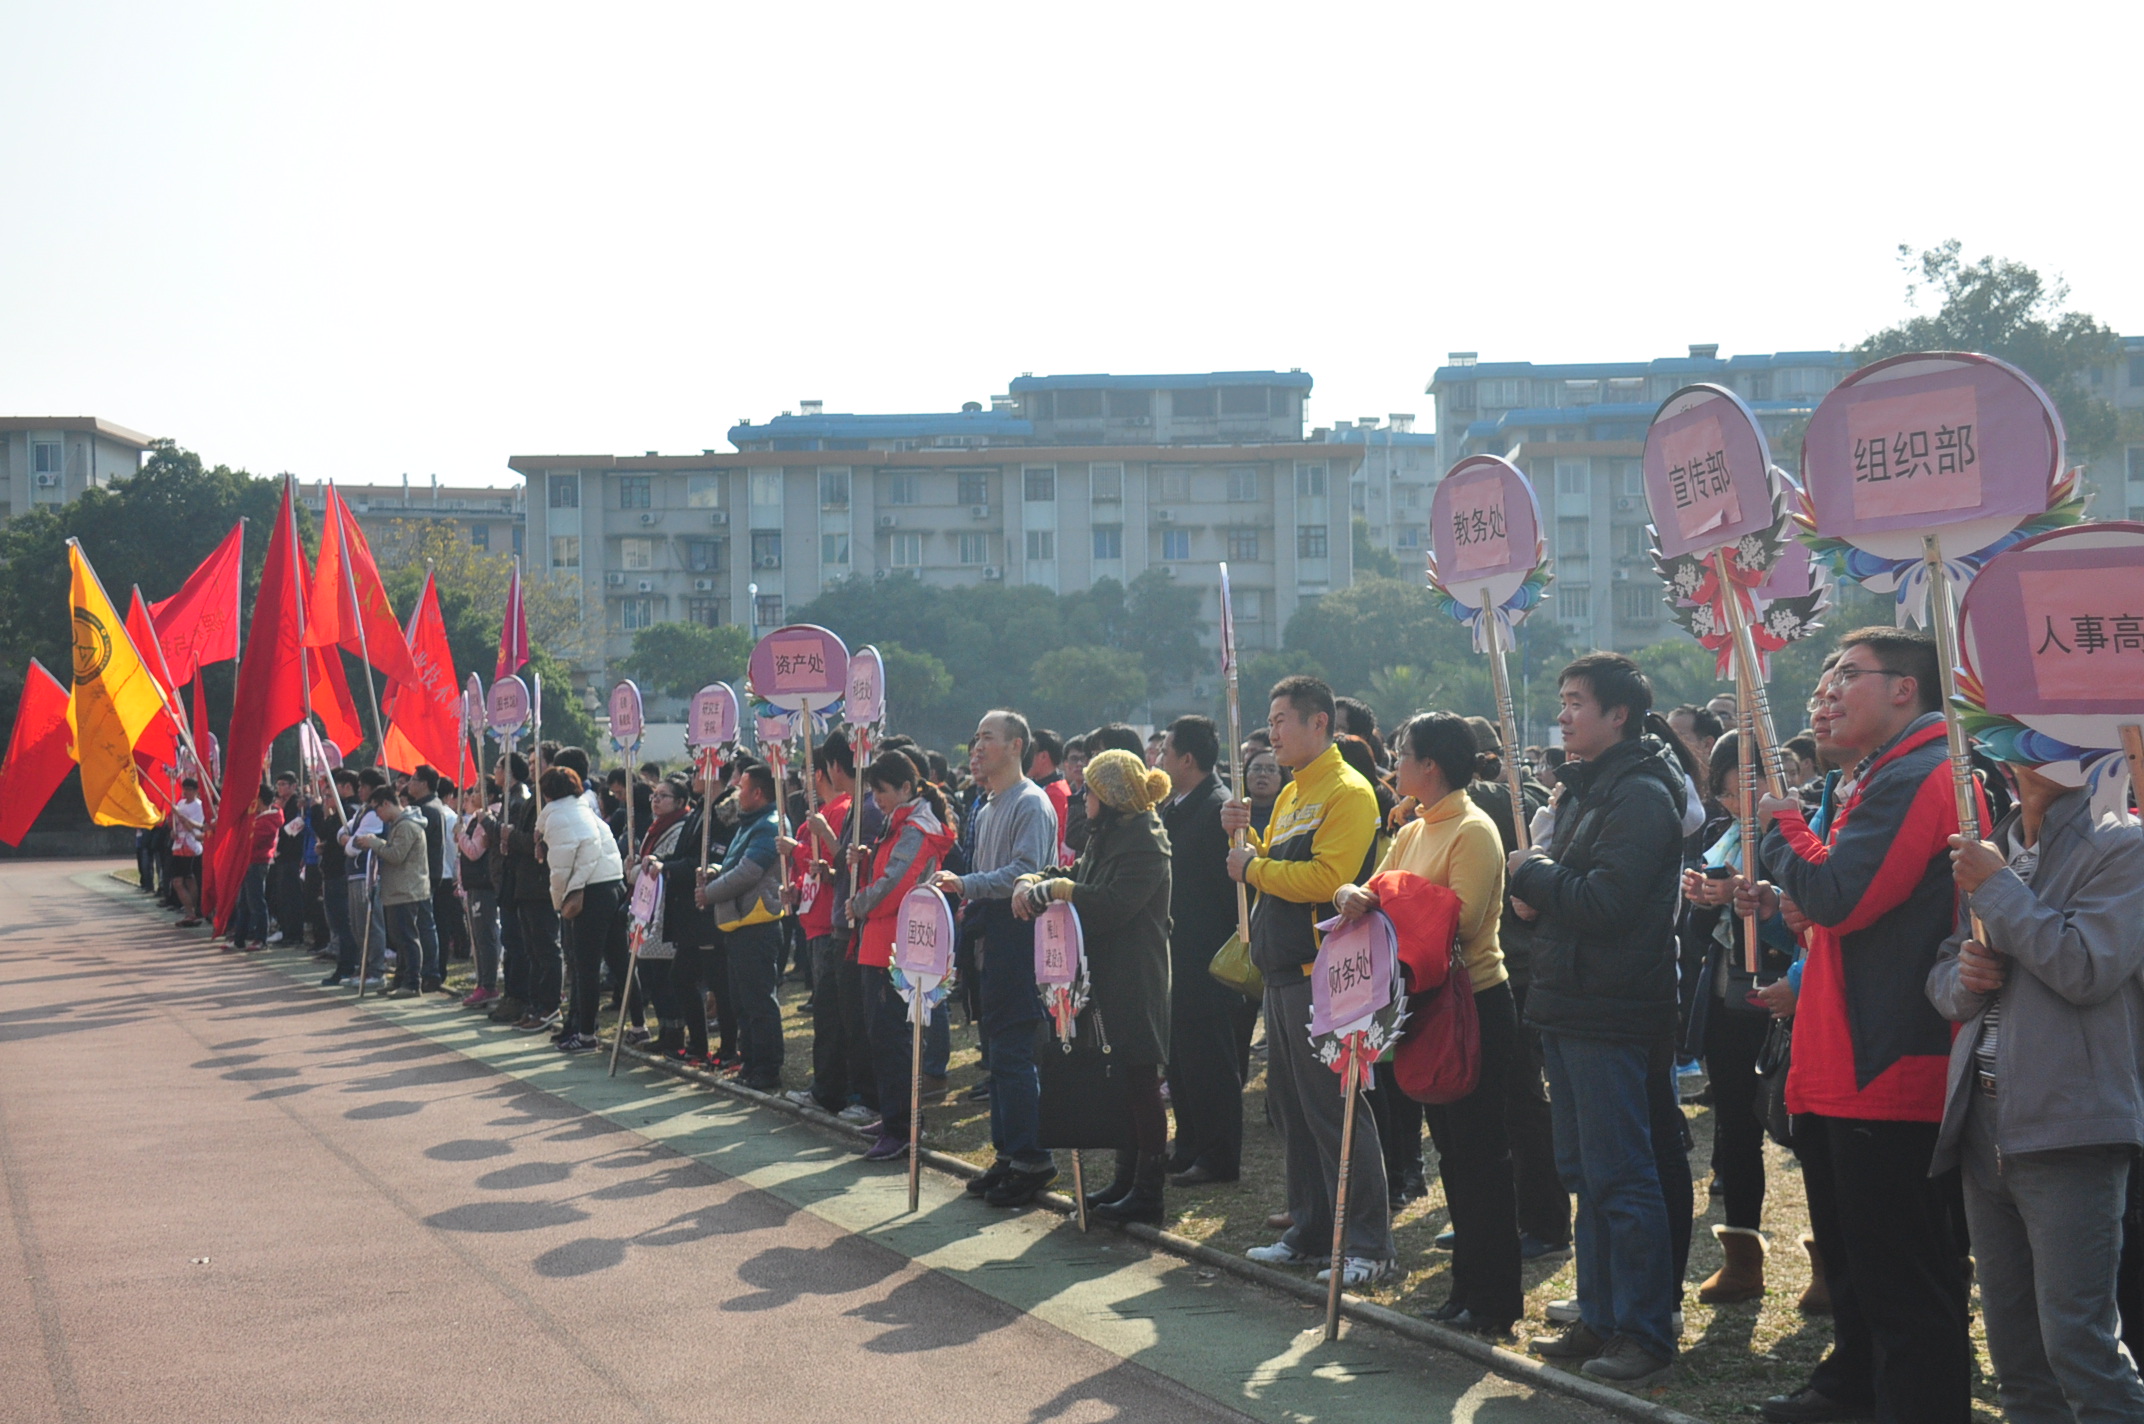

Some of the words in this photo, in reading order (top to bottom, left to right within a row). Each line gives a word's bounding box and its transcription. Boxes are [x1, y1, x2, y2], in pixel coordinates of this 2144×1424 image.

[1854, 424, 1976, 482] 组织部
[1668, 449, 1731, 509] 宣传部
[1453, 503, 1505, 546] 教务处
[2036, 613, 2144, 655] 人事高
[775, 653, 825, 676] 资产处
[702, 701, 719, 715] 研究生
[908, 919, 934, 948] 国交处
[1328, 947, 1371, 998] 财务处
